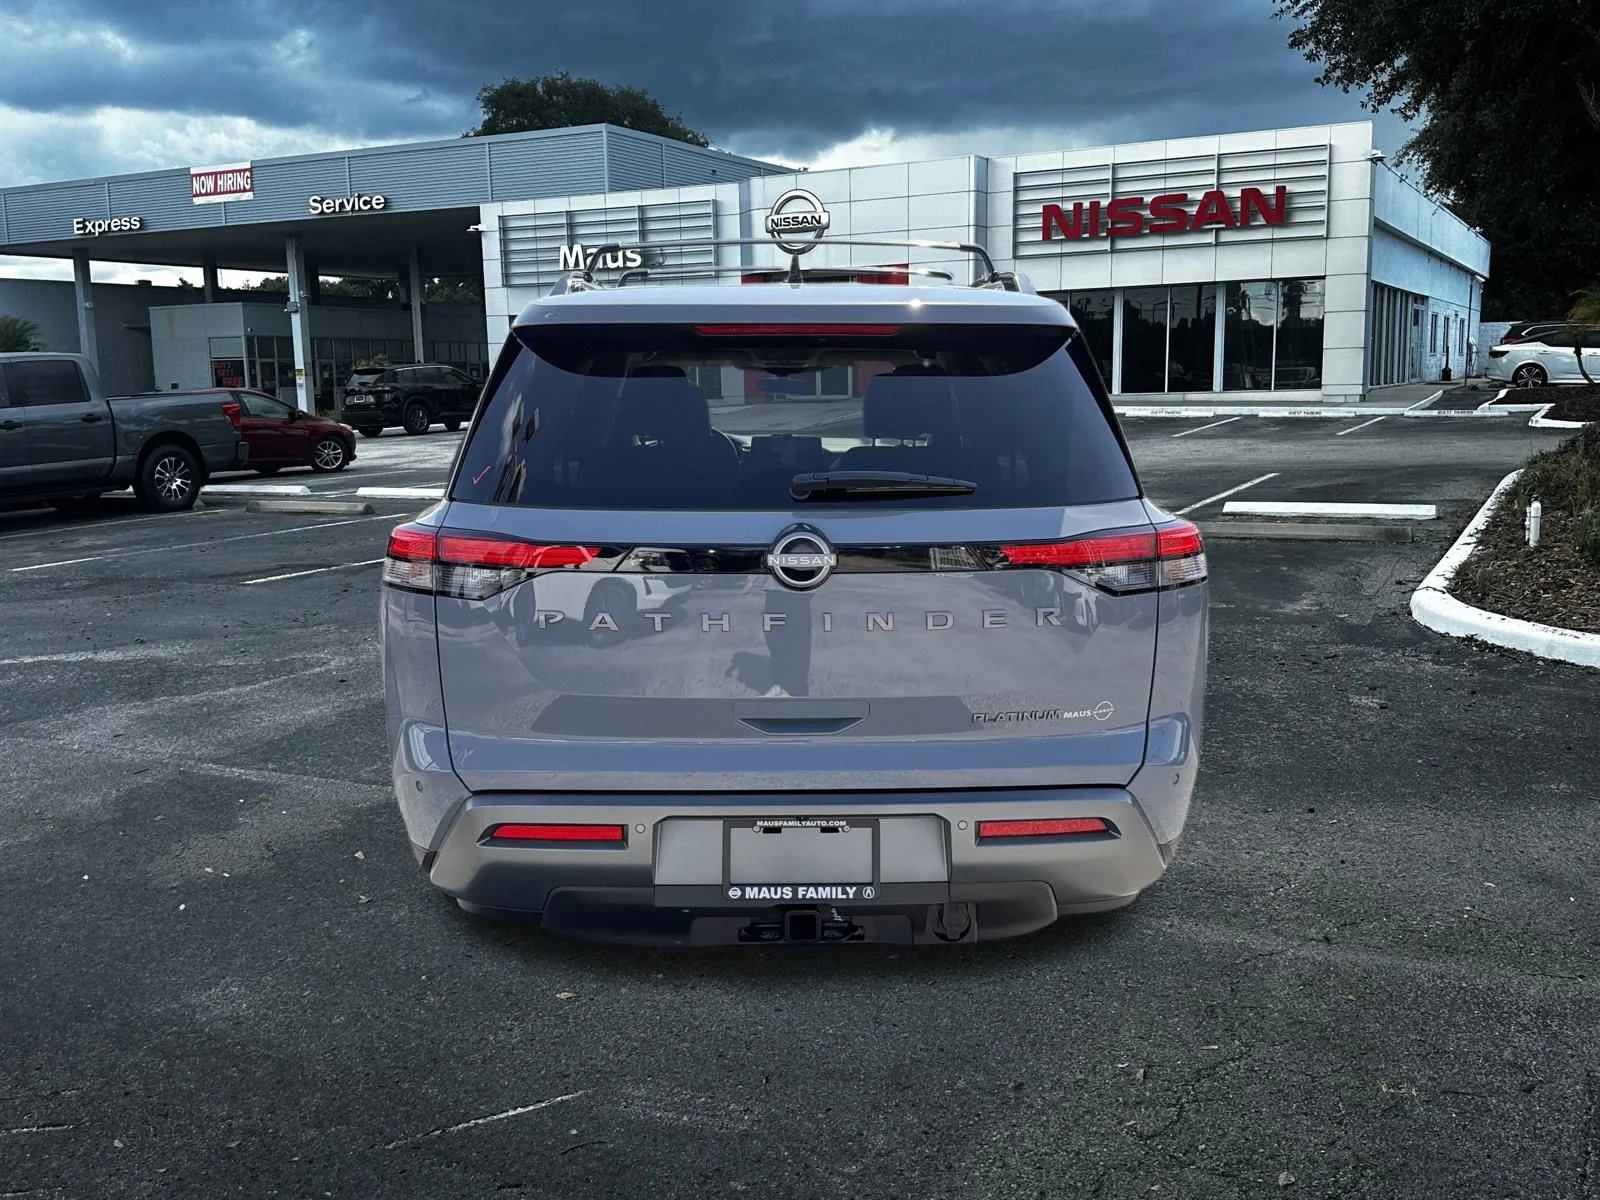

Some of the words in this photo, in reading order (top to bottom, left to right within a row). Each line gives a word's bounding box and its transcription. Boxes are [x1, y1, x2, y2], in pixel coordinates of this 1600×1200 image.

[192, 175, 215, 195] NOW
[217, 171, 251, 192] HIRING
[308, 193, 385, 215] Service
[1042, 185, 1287, 241] NISSAN
[73, 216, 141, 237] Express
[770, 214, 822, 229] NISSAN
[769, 555, 834, 565] NISSAN
[536, 606, 1064, 633] PATHFINDER
[971, 708, 1060, 724] PLATINUM
[1063, 709, 1092, 719] MAUS
[745, 886, 793, 899] MAUS
[797, 886, 857, 899] FAMILY
